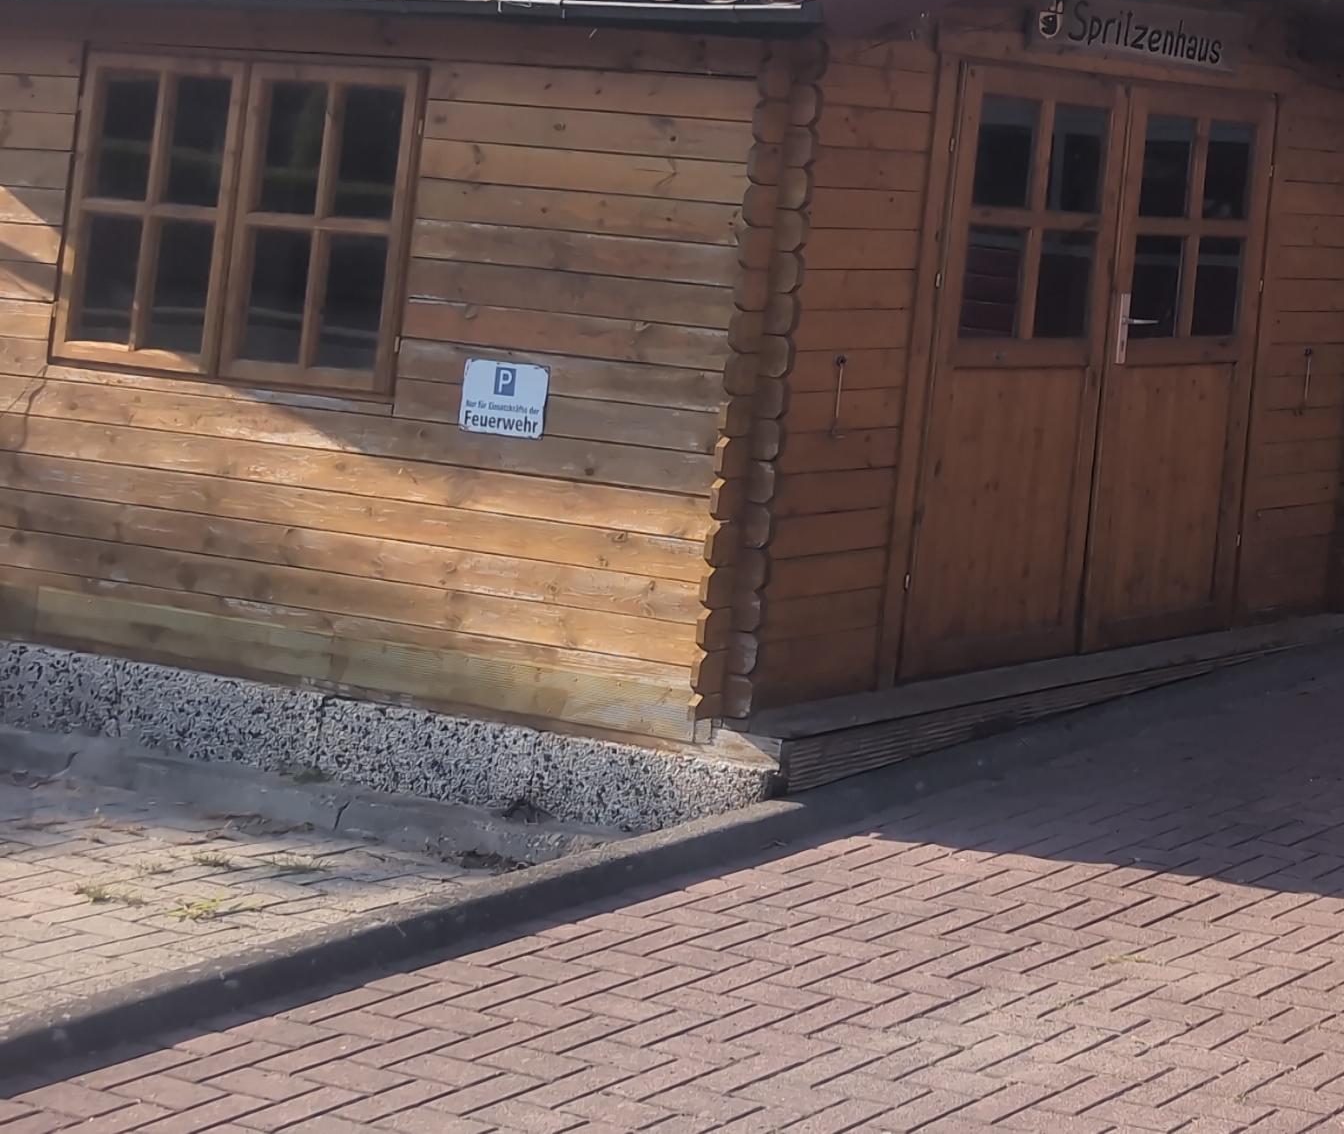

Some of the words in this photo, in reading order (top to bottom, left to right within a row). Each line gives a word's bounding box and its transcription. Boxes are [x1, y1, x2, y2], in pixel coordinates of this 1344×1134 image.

[1067, 0, 1223, 64] Spritzenhaus
[498, 370, 512, 393] P
[464, 410, 538, 433] Feuerwehr
